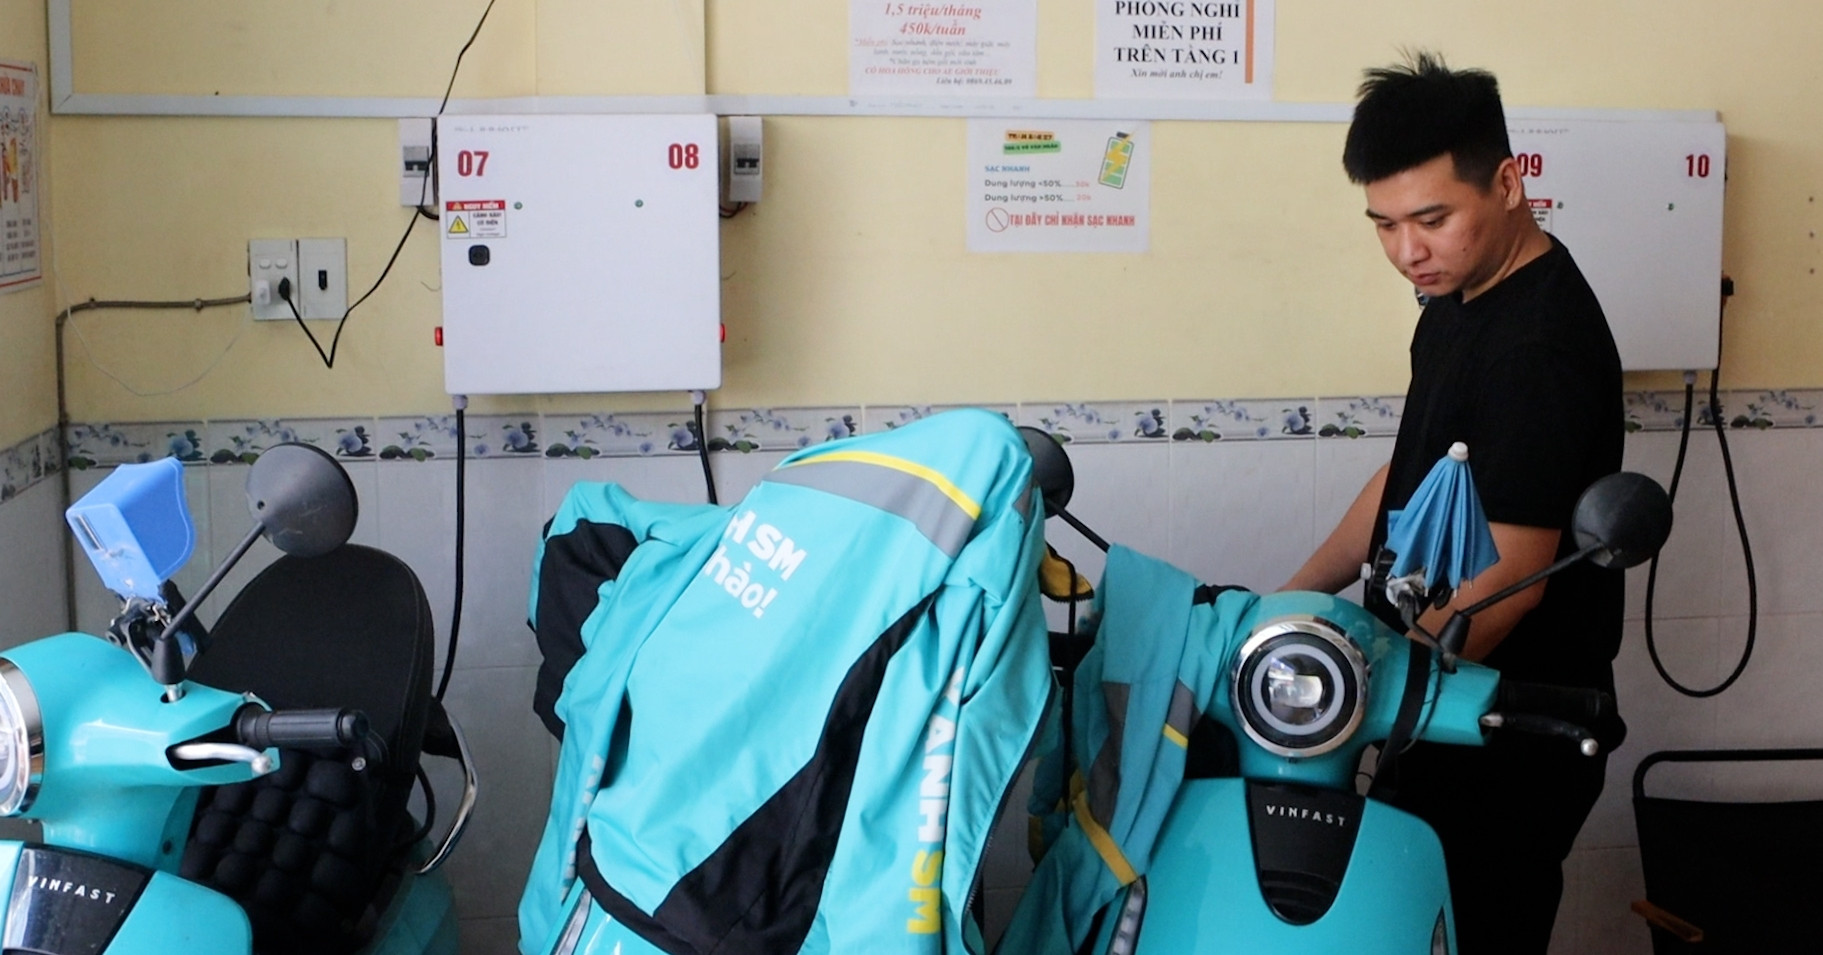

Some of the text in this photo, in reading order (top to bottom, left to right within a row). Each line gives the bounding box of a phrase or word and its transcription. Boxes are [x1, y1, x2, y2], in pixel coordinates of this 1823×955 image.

[885, 3, 982, 20] 1,5 triệu/tháng
[1190, 22, 1222, 41] PHÍ
[1114, 44, 1166, 63] TRÊN
[1233, 50, 1239, 65] 1
[1130, 68, 1147, 78] Xin
[1170, 69, 1186, 79] anh
[1205, 70, 1223, 79] em!
[457, 150, 489, 177] 07
[668, 143, 700, 169] 08
[1517, 153, 1543, 177] 09
[1685, 154, 1710, 178] 10
[747, 523, 807, 582] SM
[704, 544, 778, 619] hào!
[1266, 805, 1345, 827] VINFAST
[28, 875, 116, 904] VINFAST
[907, 850, 943, 934] SM
